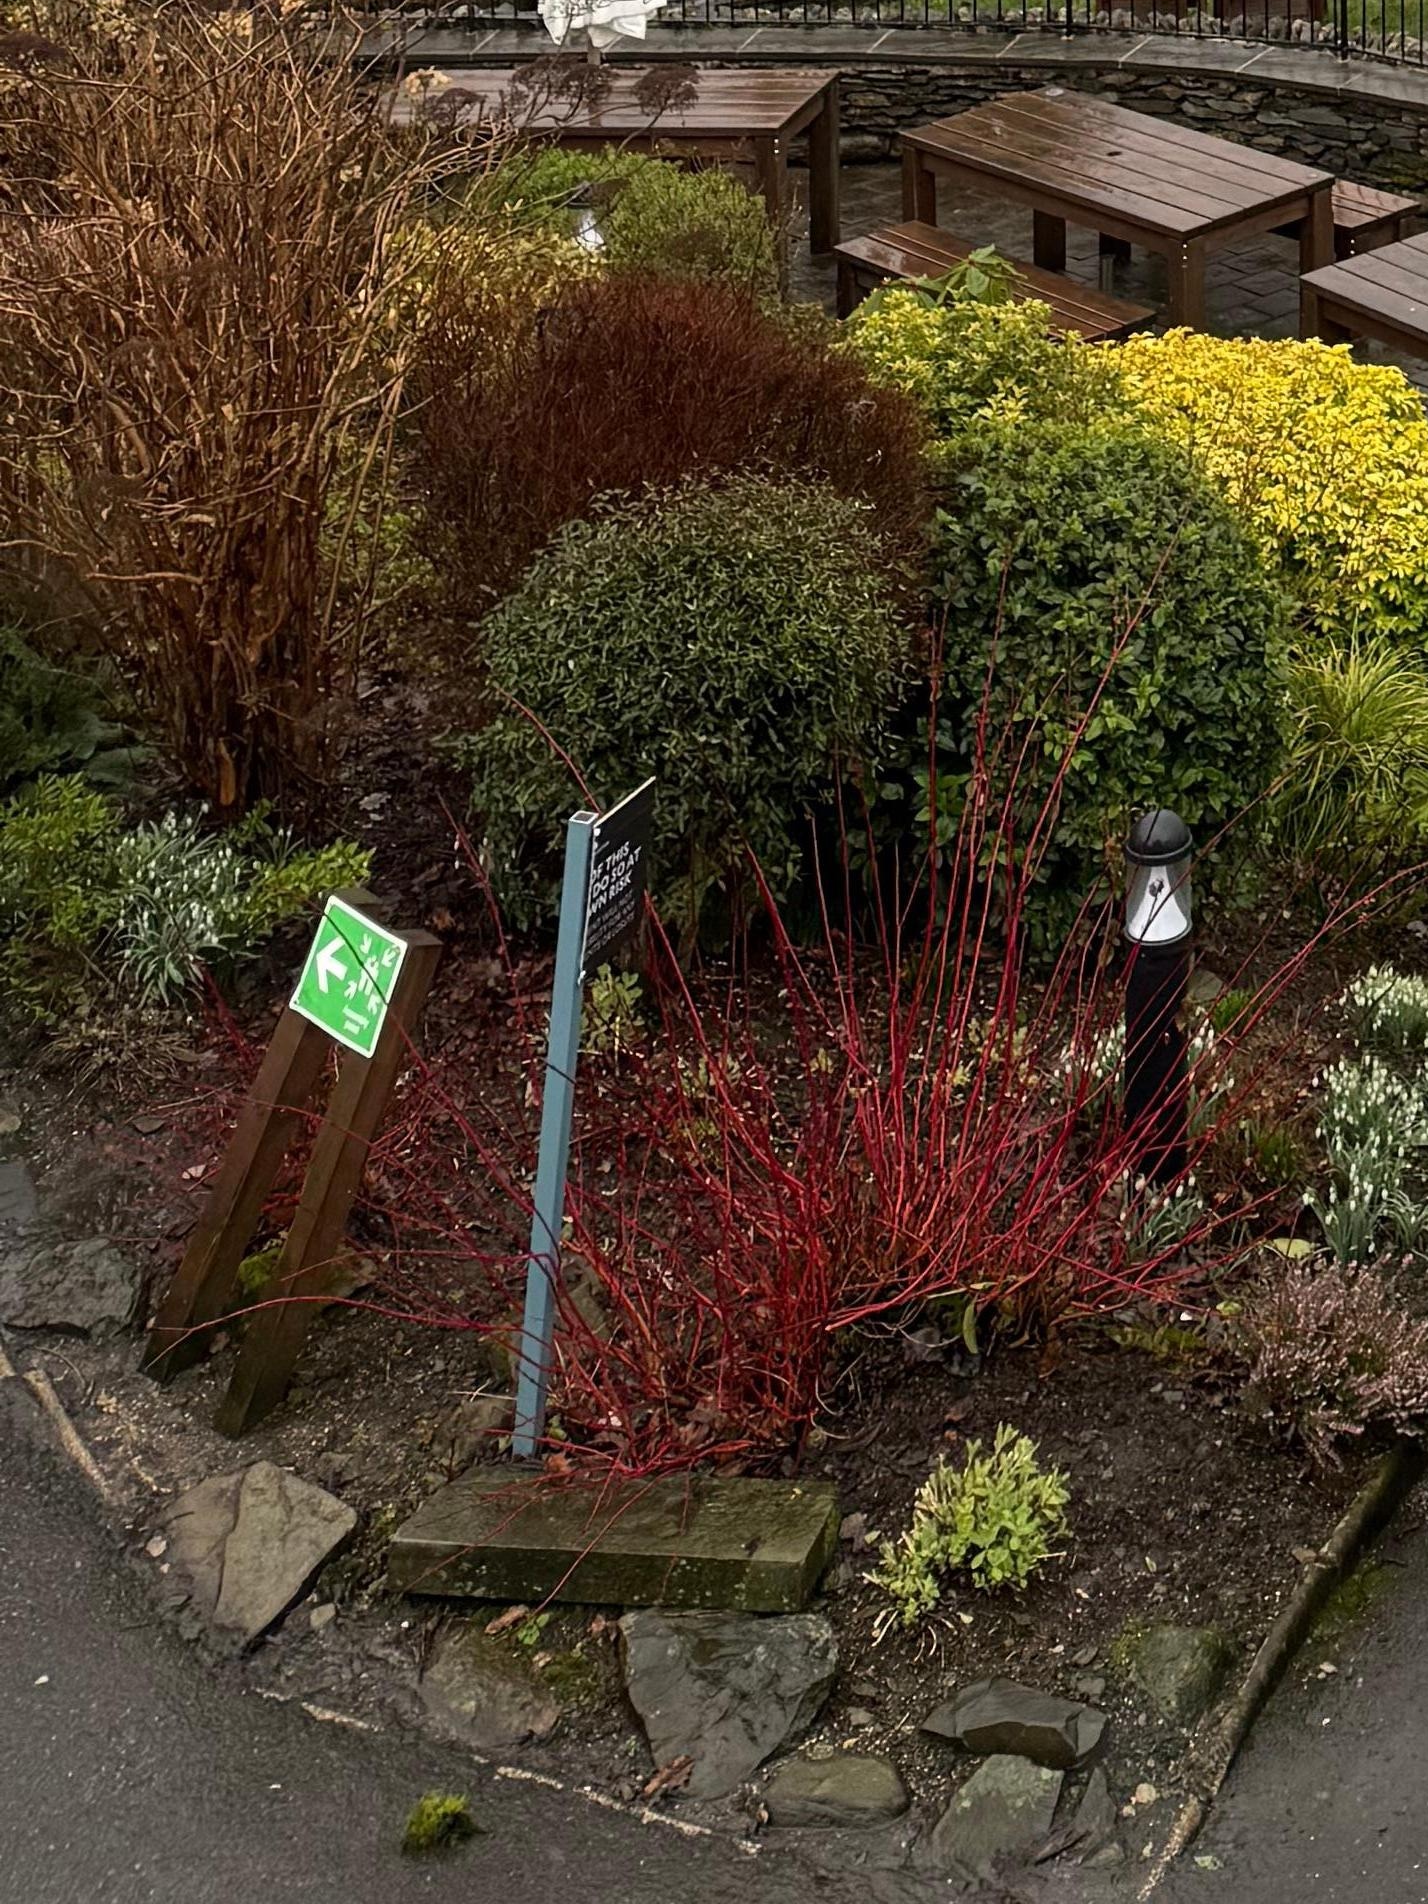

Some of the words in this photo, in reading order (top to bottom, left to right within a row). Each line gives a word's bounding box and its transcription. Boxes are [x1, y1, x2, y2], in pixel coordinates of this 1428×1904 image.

[606, 840, 630, 871] THIS
[592, 875, 610, 899] DO
[611, 860, 626, 883] SO
[625, 845, 643, 871] AT
[609, 869, 632, 900] RISK
